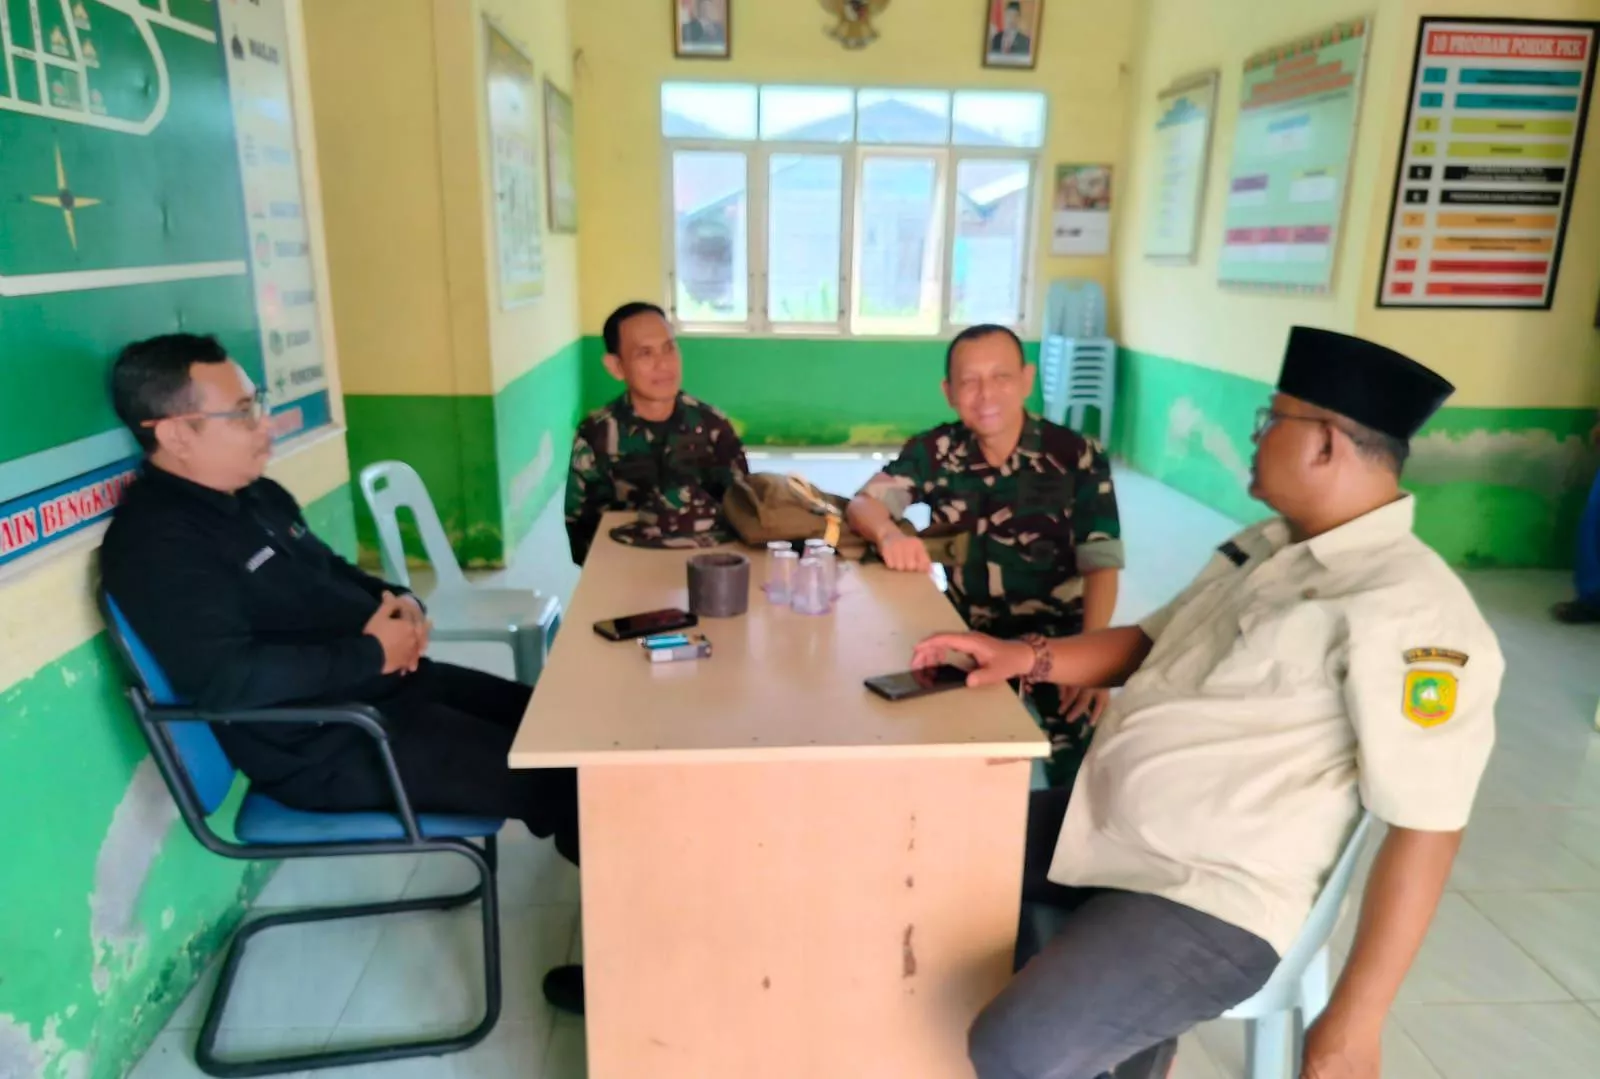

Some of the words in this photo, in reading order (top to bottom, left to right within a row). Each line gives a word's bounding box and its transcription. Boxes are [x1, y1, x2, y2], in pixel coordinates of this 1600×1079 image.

[1450, 35, 1508, 54] PROGRAM
[1510, 37, 1553, 56] POKOK
[1555, 39, 1582, 57] PKK
[40, 469, 137, 538] BENGKAL
